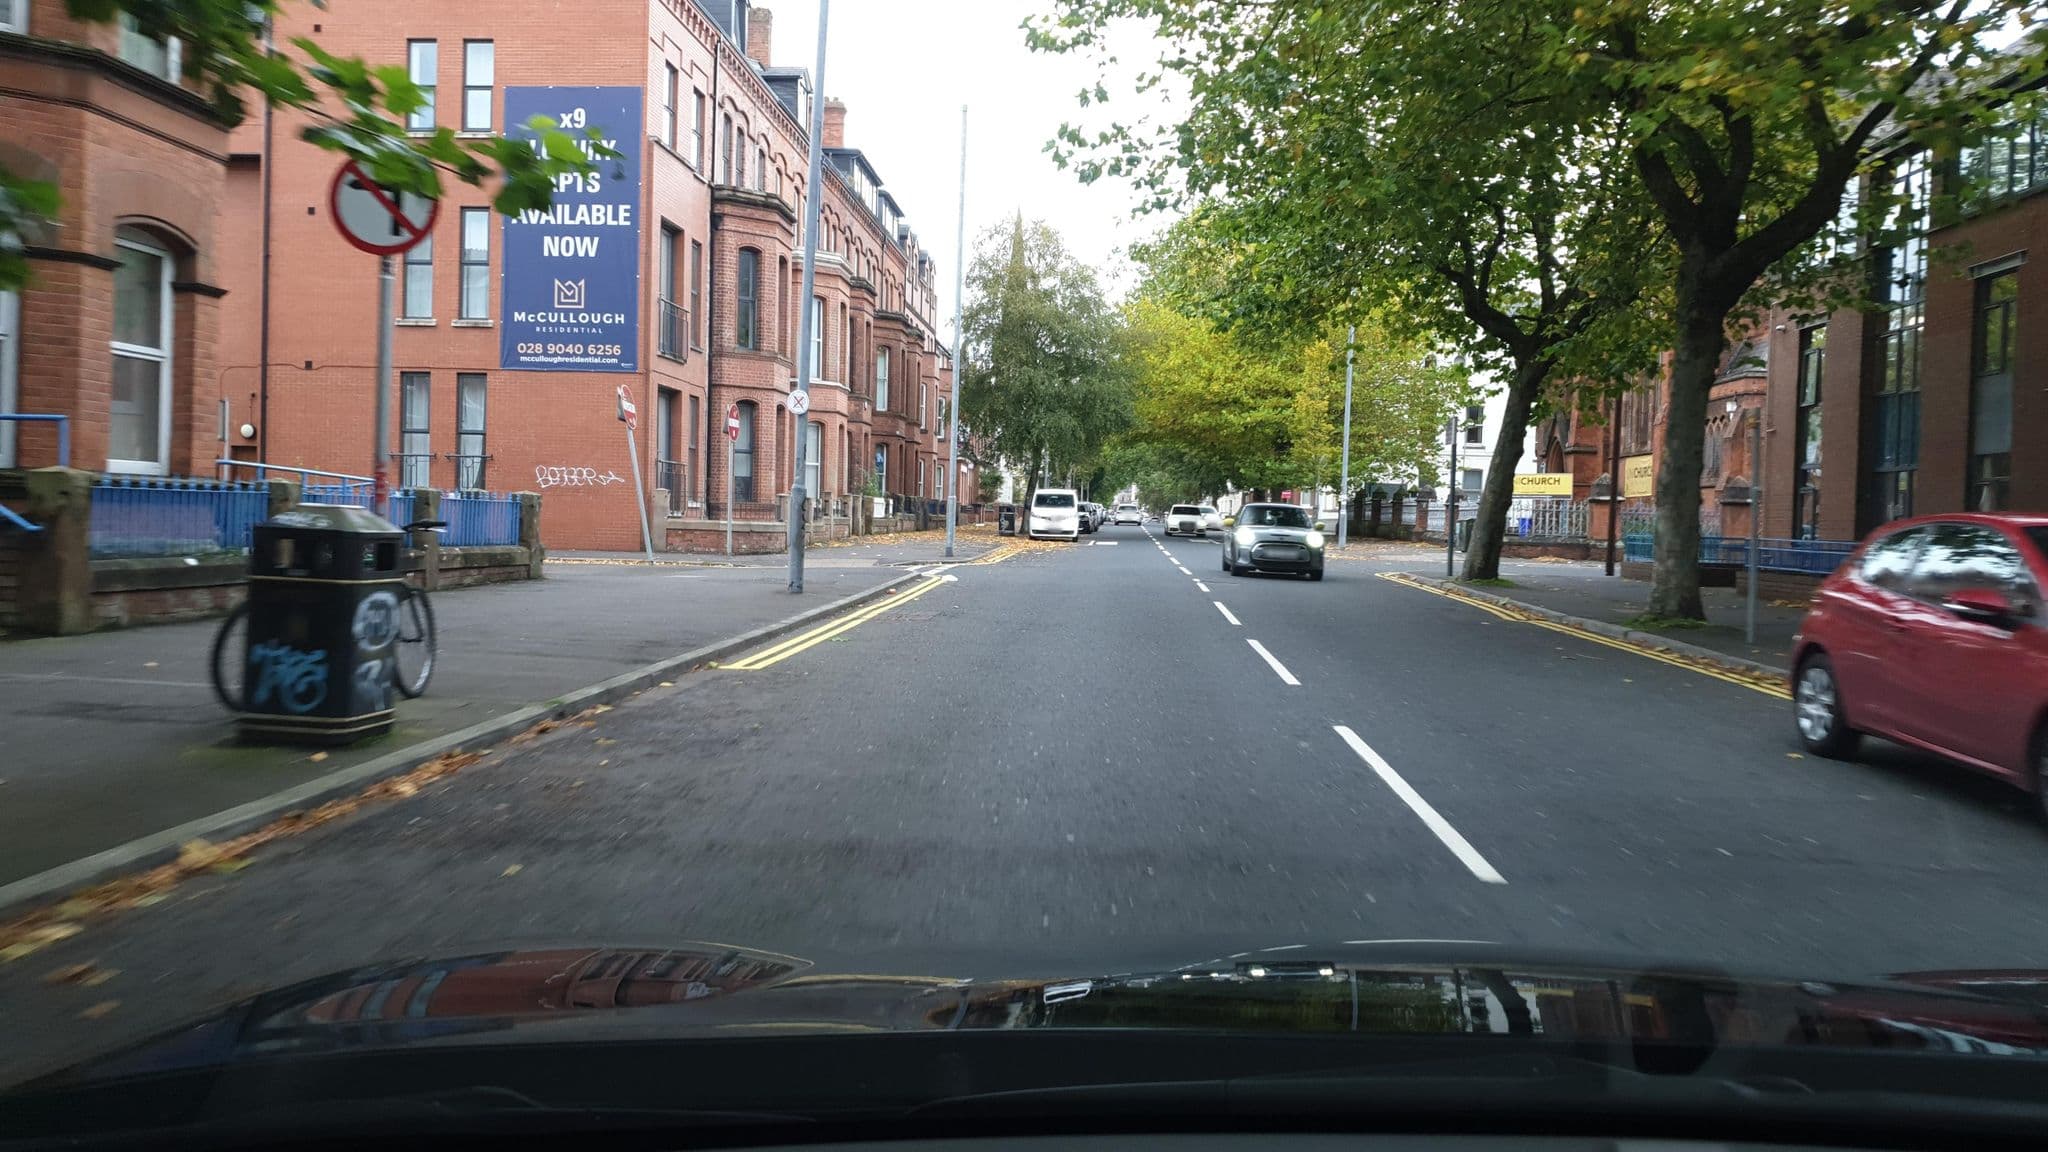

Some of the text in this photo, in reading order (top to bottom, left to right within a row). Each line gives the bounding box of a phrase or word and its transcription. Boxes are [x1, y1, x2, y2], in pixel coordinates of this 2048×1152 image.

[560, 108, 585, 128] x9
[512, 204, 631, 225] AVAILABLE
[543, 236, 599, 257] NOW
[514, 312, 625, 324] McCULLOUGH
[536, 326, 603, 334] RESIDENTIAL
[517, 343, 621, 356] 028 9040 6256
[520, 355, 618, 364] mcculloughresidential.com
[1520, 477, 1561, 486] CHURCH
